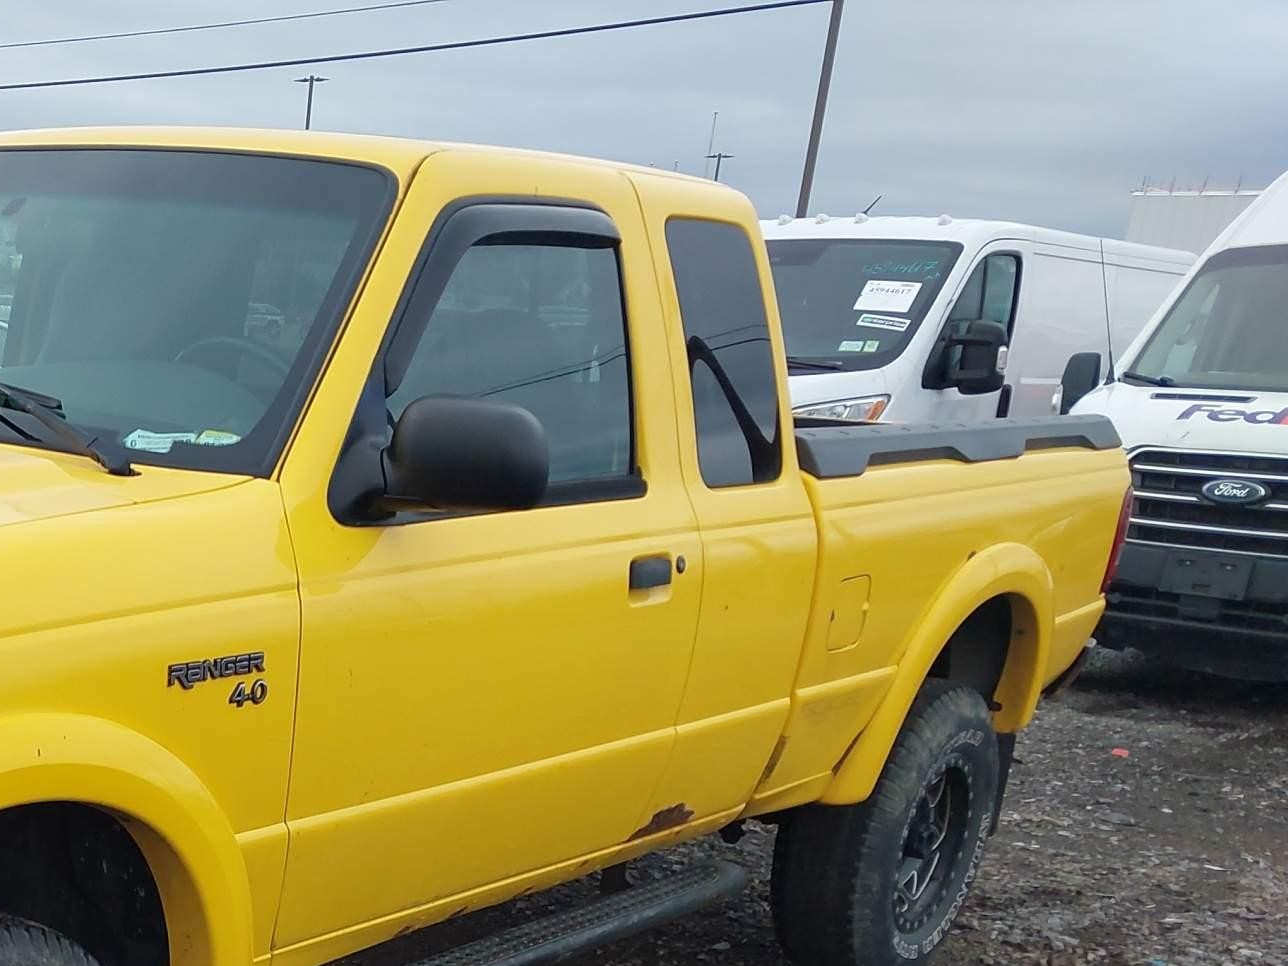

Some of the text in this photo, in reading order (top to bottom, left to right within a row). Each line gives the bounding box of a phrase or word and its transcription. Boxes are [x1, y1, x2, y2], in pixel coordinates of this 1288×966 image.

[1176, 404, 1288, 425] Fed
[1214, 482, 1250, 498] Ford
[167, 652, 265, 690] RANGER
